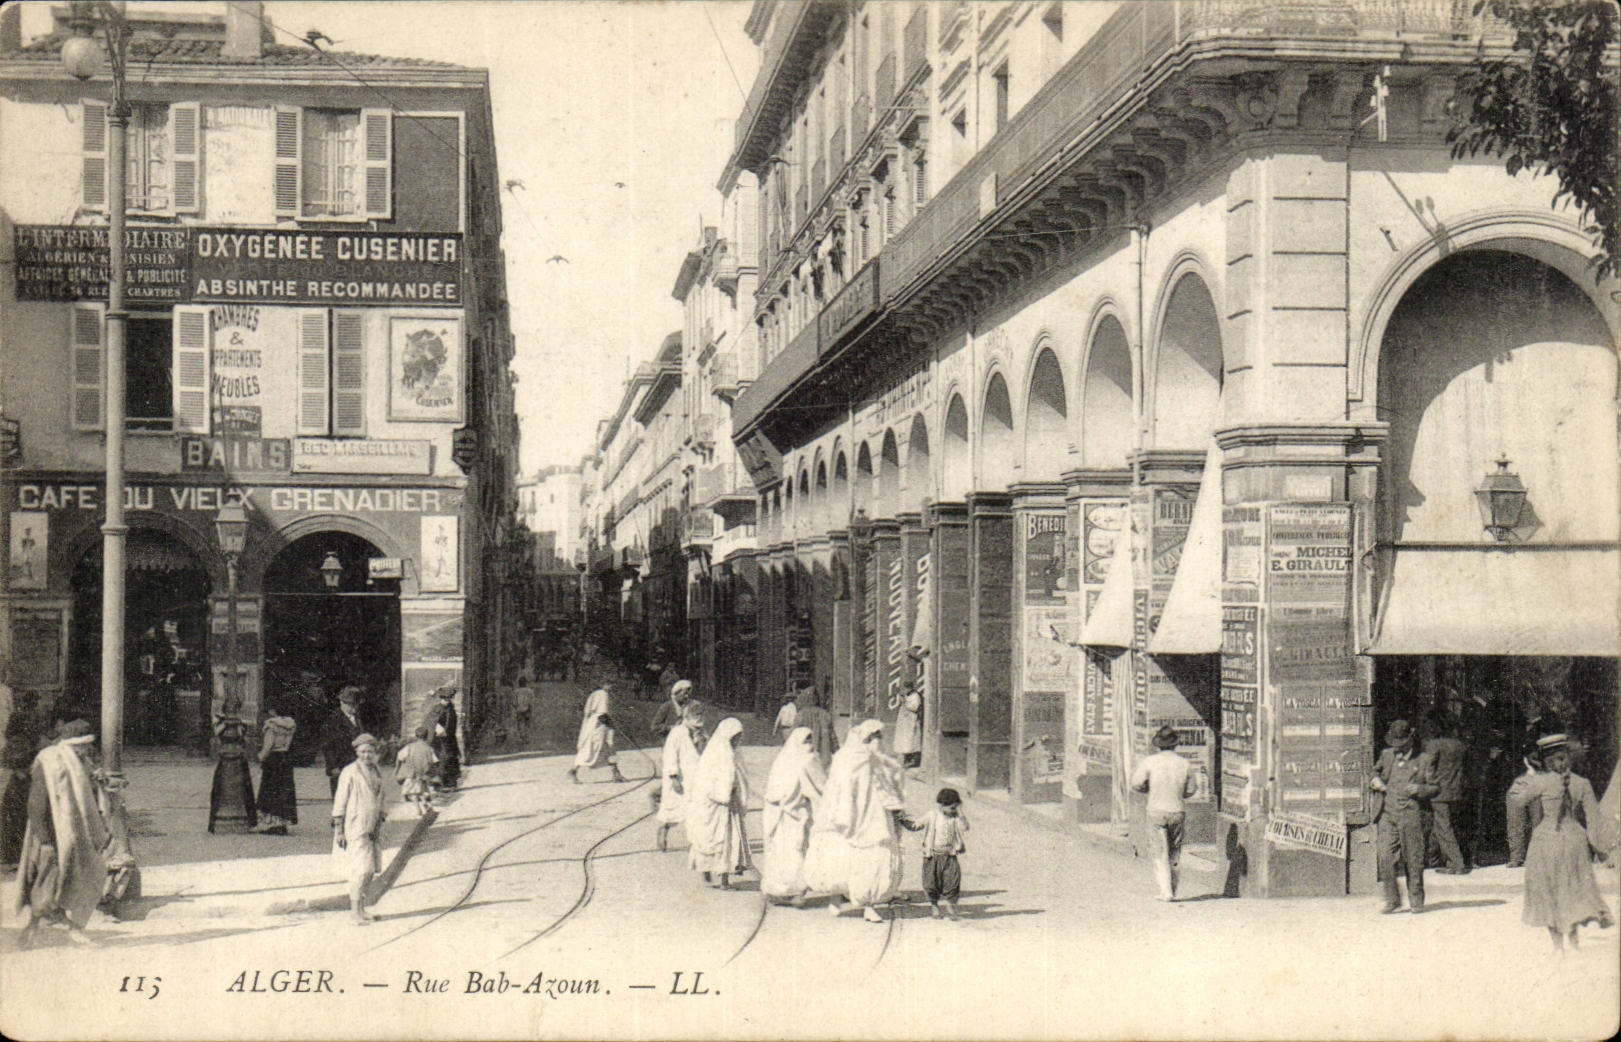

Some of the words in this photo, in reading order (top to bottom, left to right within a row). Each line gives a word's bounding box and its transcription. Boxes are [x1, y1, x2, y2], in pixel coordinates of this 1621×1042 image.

[198, 233, 324, 260] OXYGÉNÉE
[337, 237, 457, 262] CUSENIER
[128, 287, 182, 298] CHARTRES
[196, 279, 297, 297] ABSINTHE
[308, 282, 457, 300] RECOMMANDÉE
[229, 331, 244, 345] &
[186, 439, 287, 470] BAINS
[19, 485, 97, 509] CAFE
[171, 487, 254, 511] VIEUX
[271, 487, 441, 511] GRENADIER
[1296, 547, 1353, 559] MICHEL
[1286, 560, 1353, 571] GIRAULT
